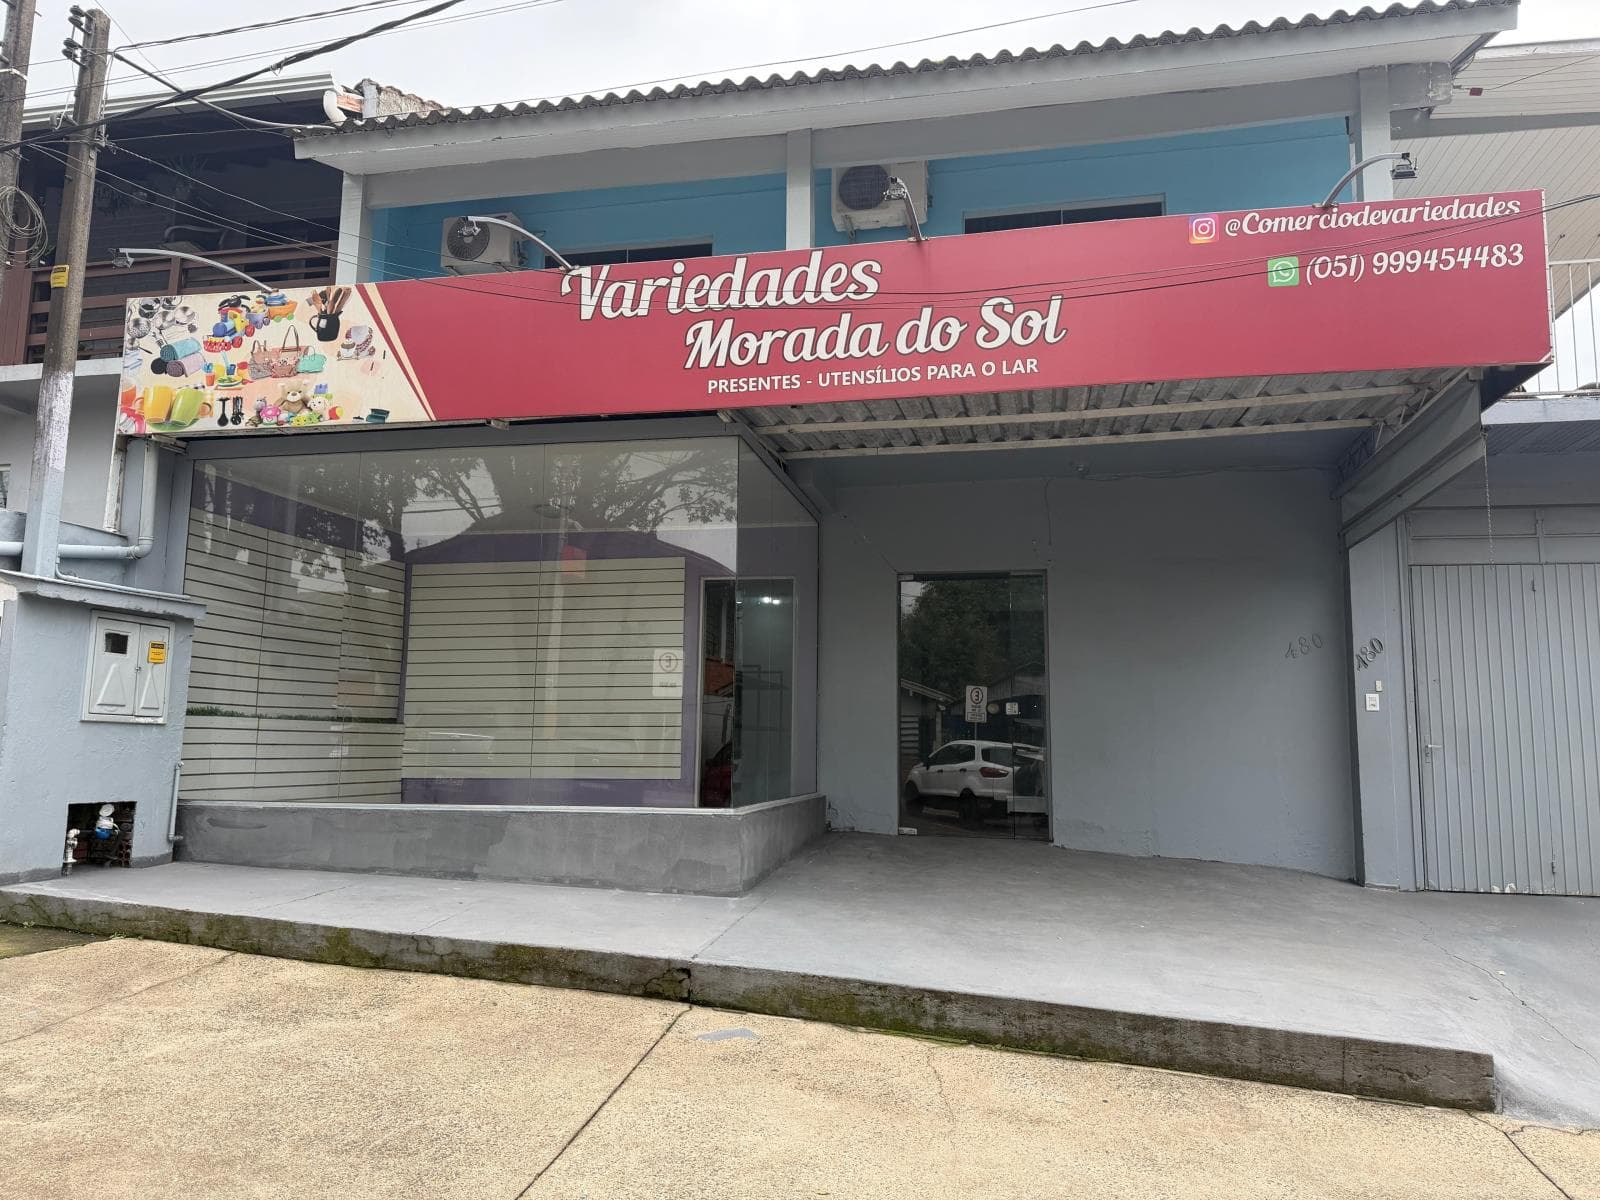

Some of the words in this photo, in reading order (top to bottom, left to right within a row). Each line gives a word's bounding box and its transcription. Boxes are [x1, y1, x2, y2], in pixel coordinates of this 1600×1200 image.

[1225, 197, 1521, 237] @Comerciodevariedades
[1306, 254, 1365, 286] (051)
[1372, 243, 1524, 275] 999454483
[561, 250, 882, 321] Variedades
[684, 312, 889, 370] Morada
[896, 306, 968, 354] do
[975, 294, 1067, 350] Sol
[707, 373, 801, 394] PRESENTES
[818, 364, 921, 388] UTENSÍLIOS
[927, 361, 976, 380] PARA
[981, 360, 996, 376] O
[1002, 358, 1039, 375] LAR
[1285, 633, 1323, 659] 480
[1356, 637, 1384, 671] 480
